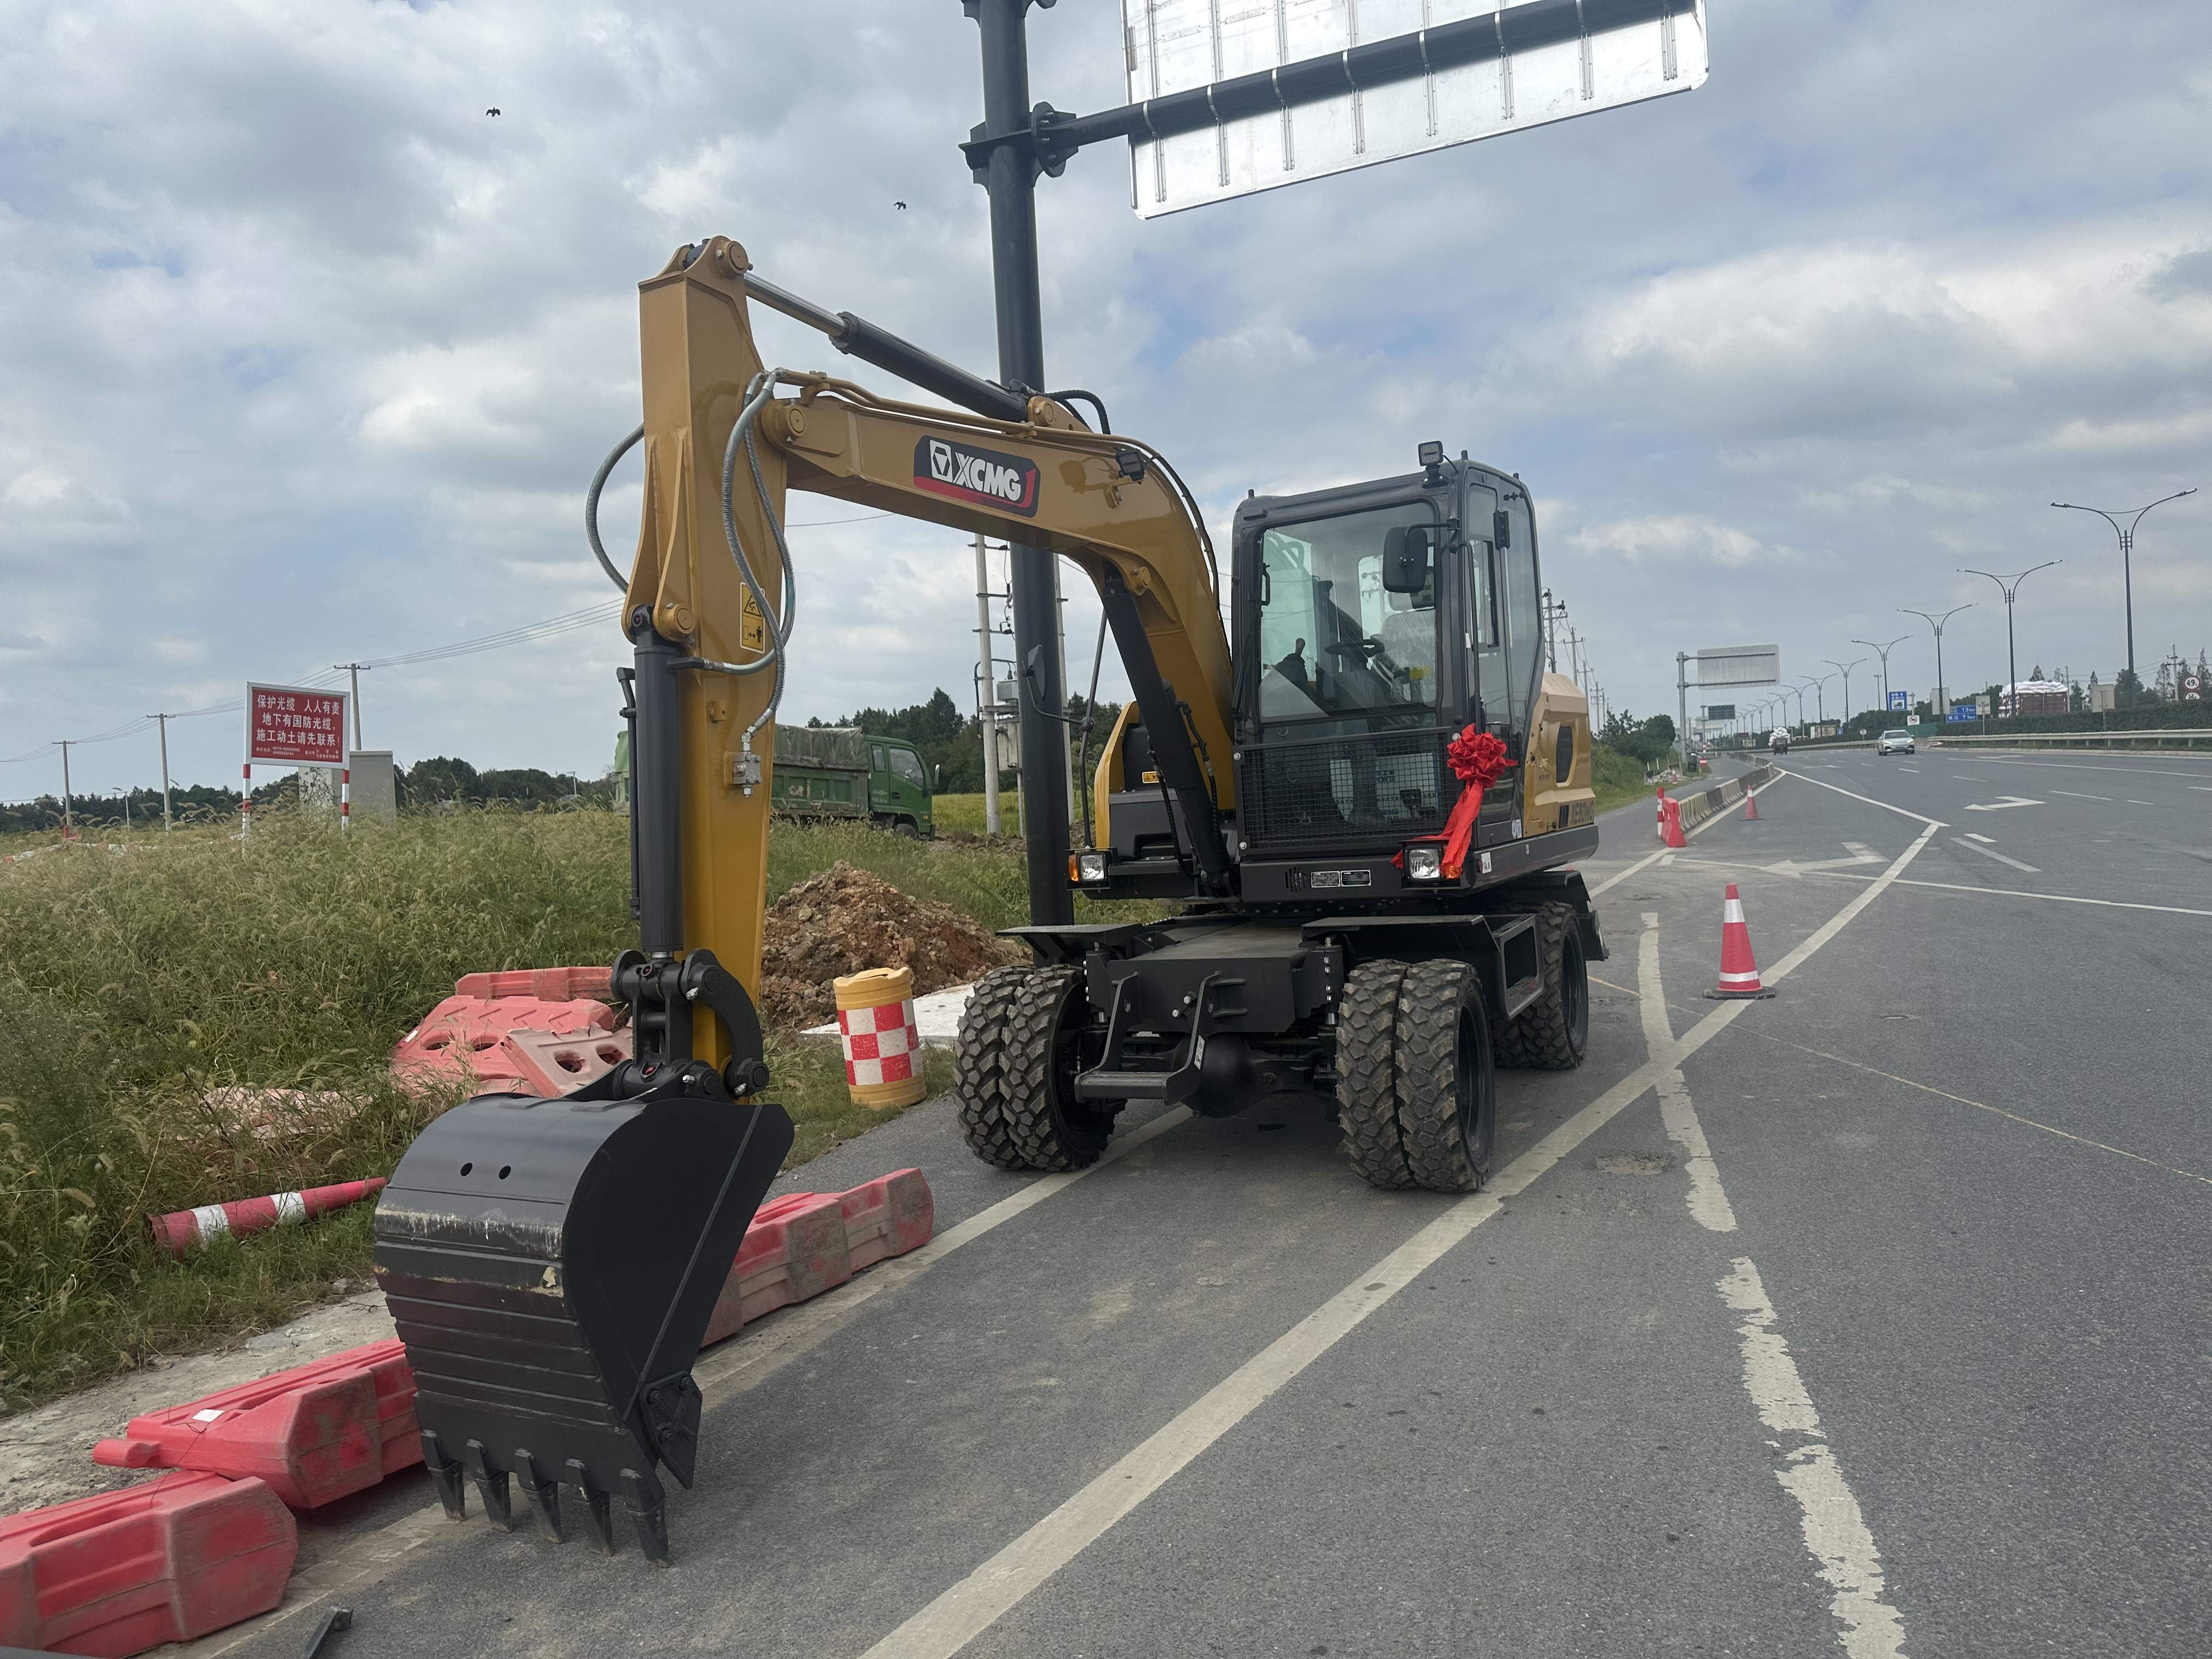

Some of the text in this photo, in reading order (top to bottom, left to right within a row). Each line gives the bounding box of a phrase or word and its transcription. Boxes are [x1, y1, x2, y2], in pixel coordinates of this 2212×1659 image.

[953, 452, 1021, 501] XCMG
[257, 694, 340, 715] 保护光缆 人人有责
